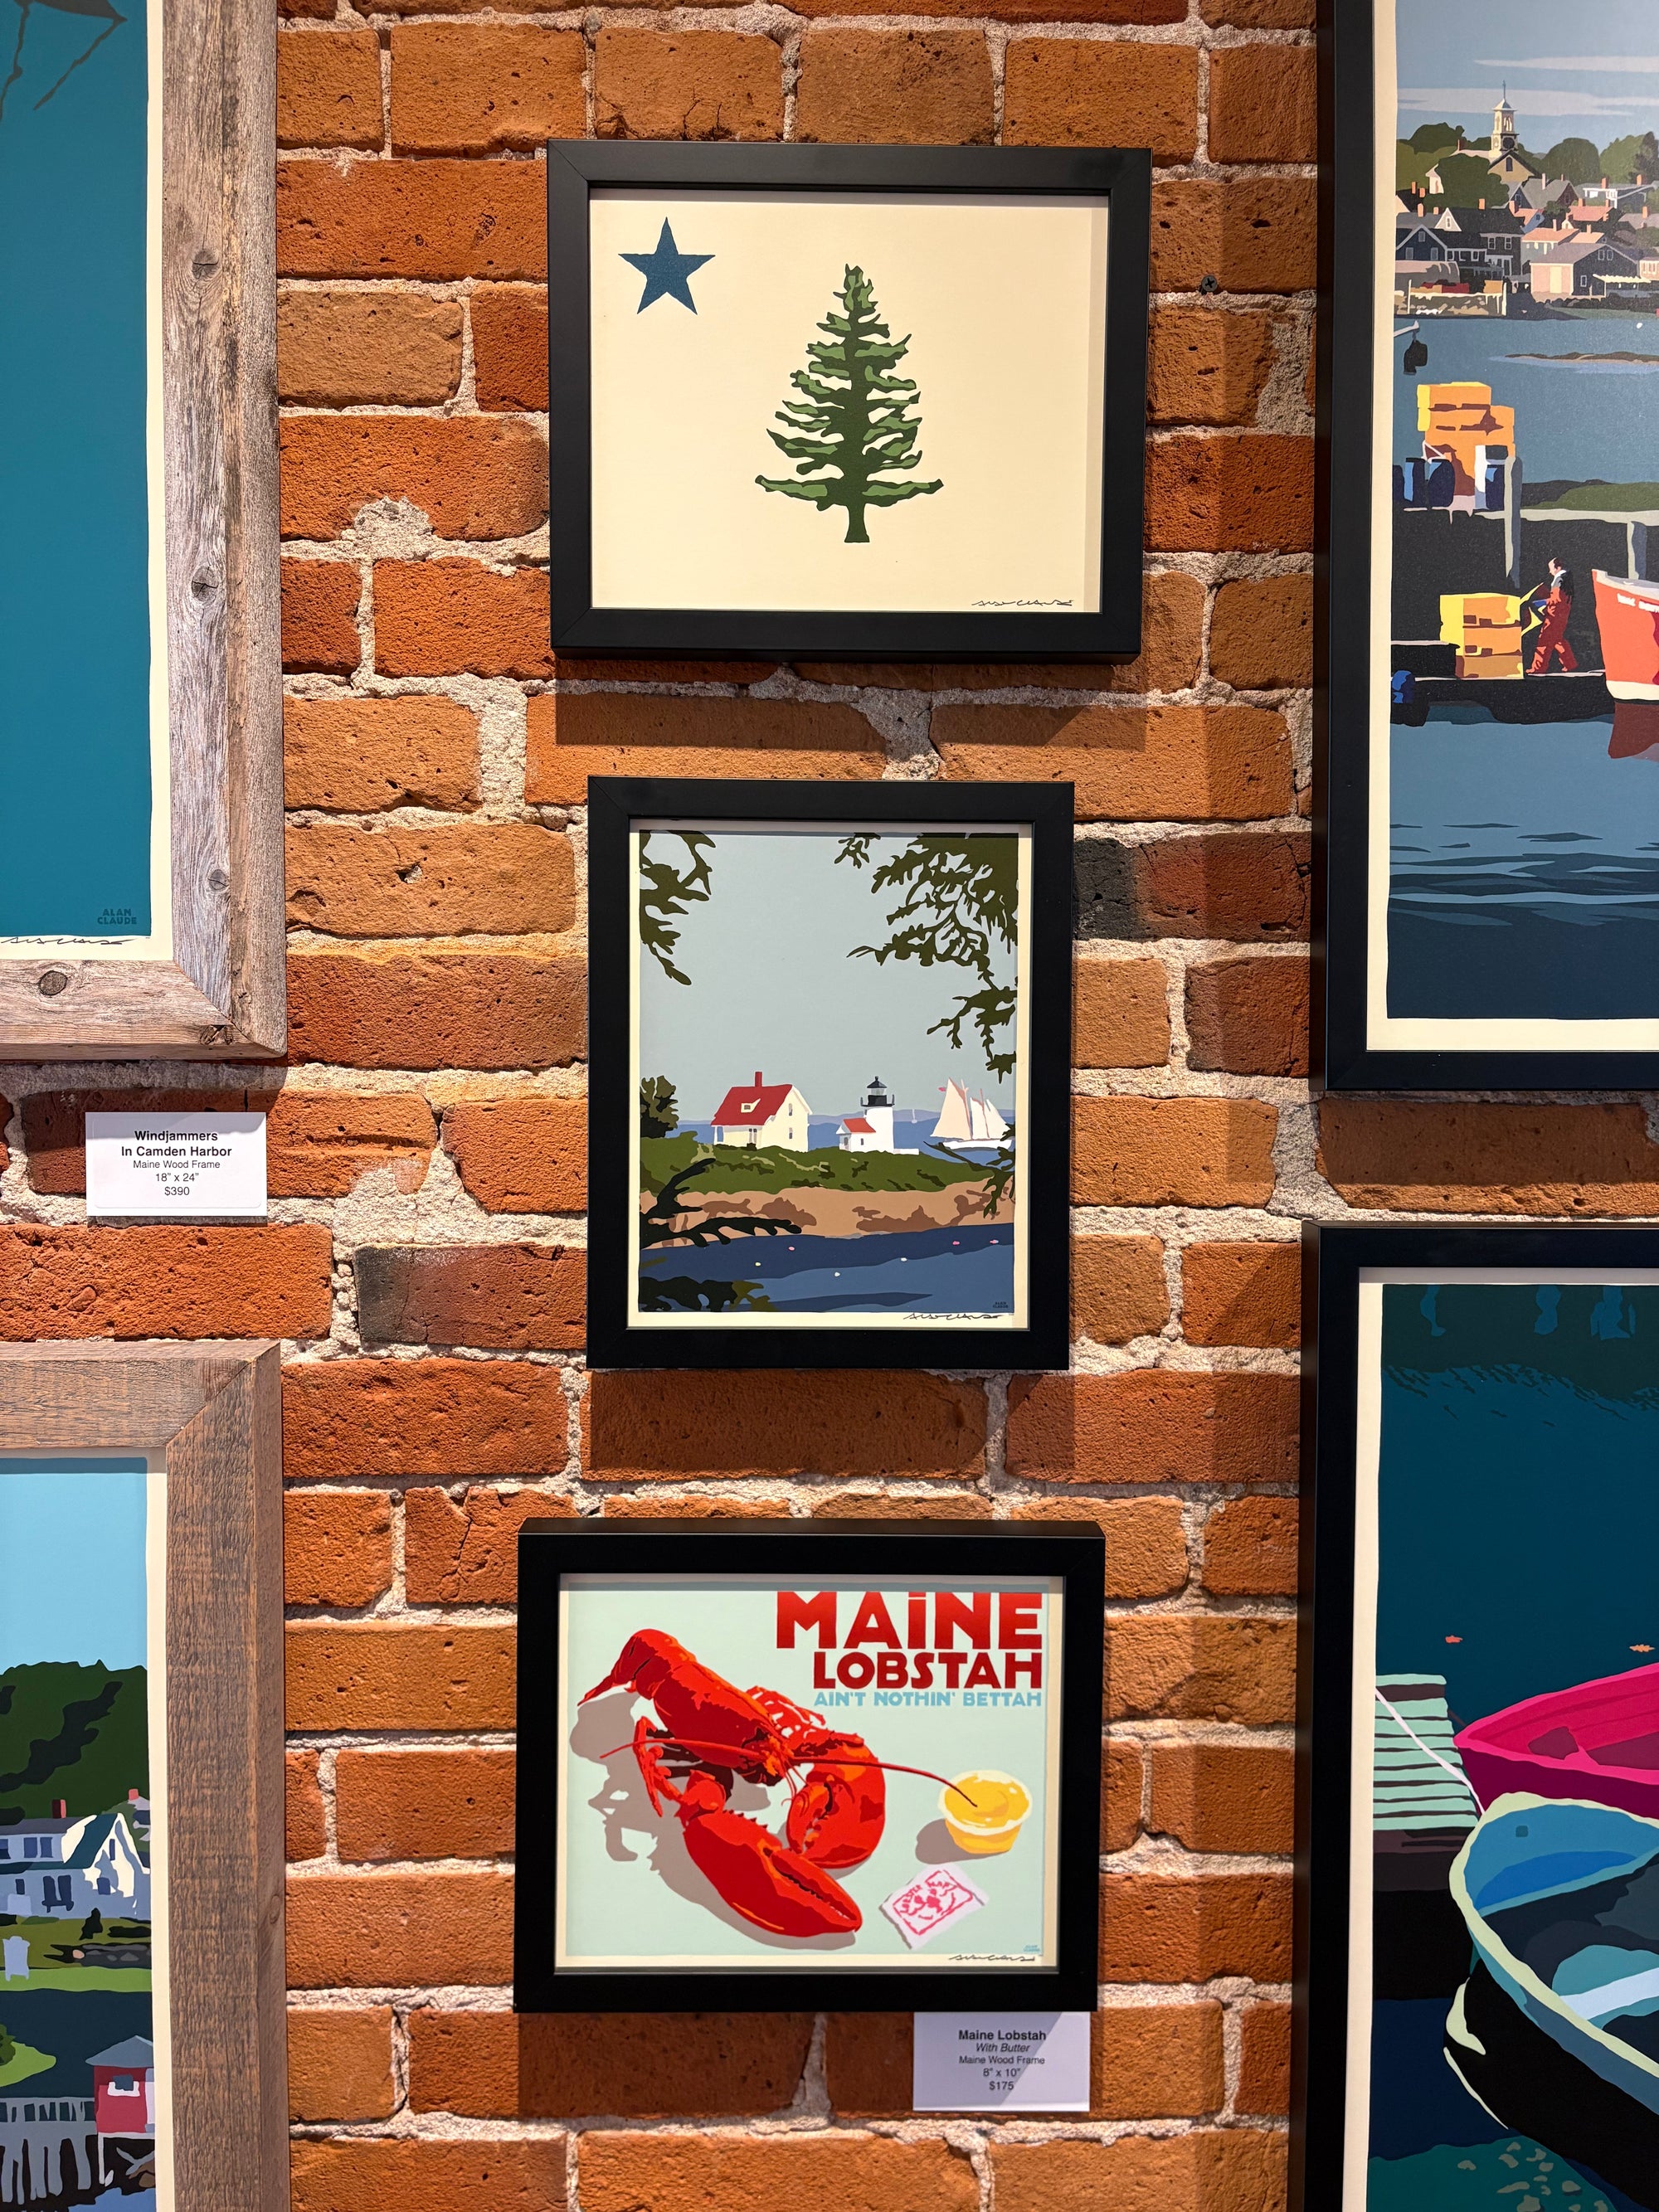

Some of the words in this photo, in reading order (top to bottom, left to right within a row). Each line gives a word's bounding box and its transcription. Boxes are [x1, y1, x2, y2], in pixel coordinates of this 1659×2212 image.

[102, 908, 132, 916] ALAN
[97, 916, 137, 925] CLAUDE
[134, 1130, 218, 1143] Windjammers
[121, 1146, 132, 1156] In
[136, 1146, 187, 1156] Camden
[190, 1146, 232, 1156] Harbor
[133, 1160, 160, 1169] Maine
[163, 1160, 189, 1169] Wood
[192, 1160, 221, 1169] Frame
[164, 1186, 190, 1196] $390
[813, 1651, 1043, 1689] LOBSTAH
[814, 1691, 866, 1707] AIN'T
[873, 1691, 956, 1707] NOTHIN'
[962, 1691, 1043, 1707] BETTAH
[958, 2030, 995, 2041] Maine
[997, 2030, 1047, 2041] Lobstah
[975, 2043, 998, 2053] With
[1000, 2043, 1031, 2053] Butter
[958, 2055, 986, 2064] Maine
[988, 2055, 1014, 2064] Wood
[1016, 2055, 1045, 2065] Frame
[989, 2080, 1014, 2091] $175
